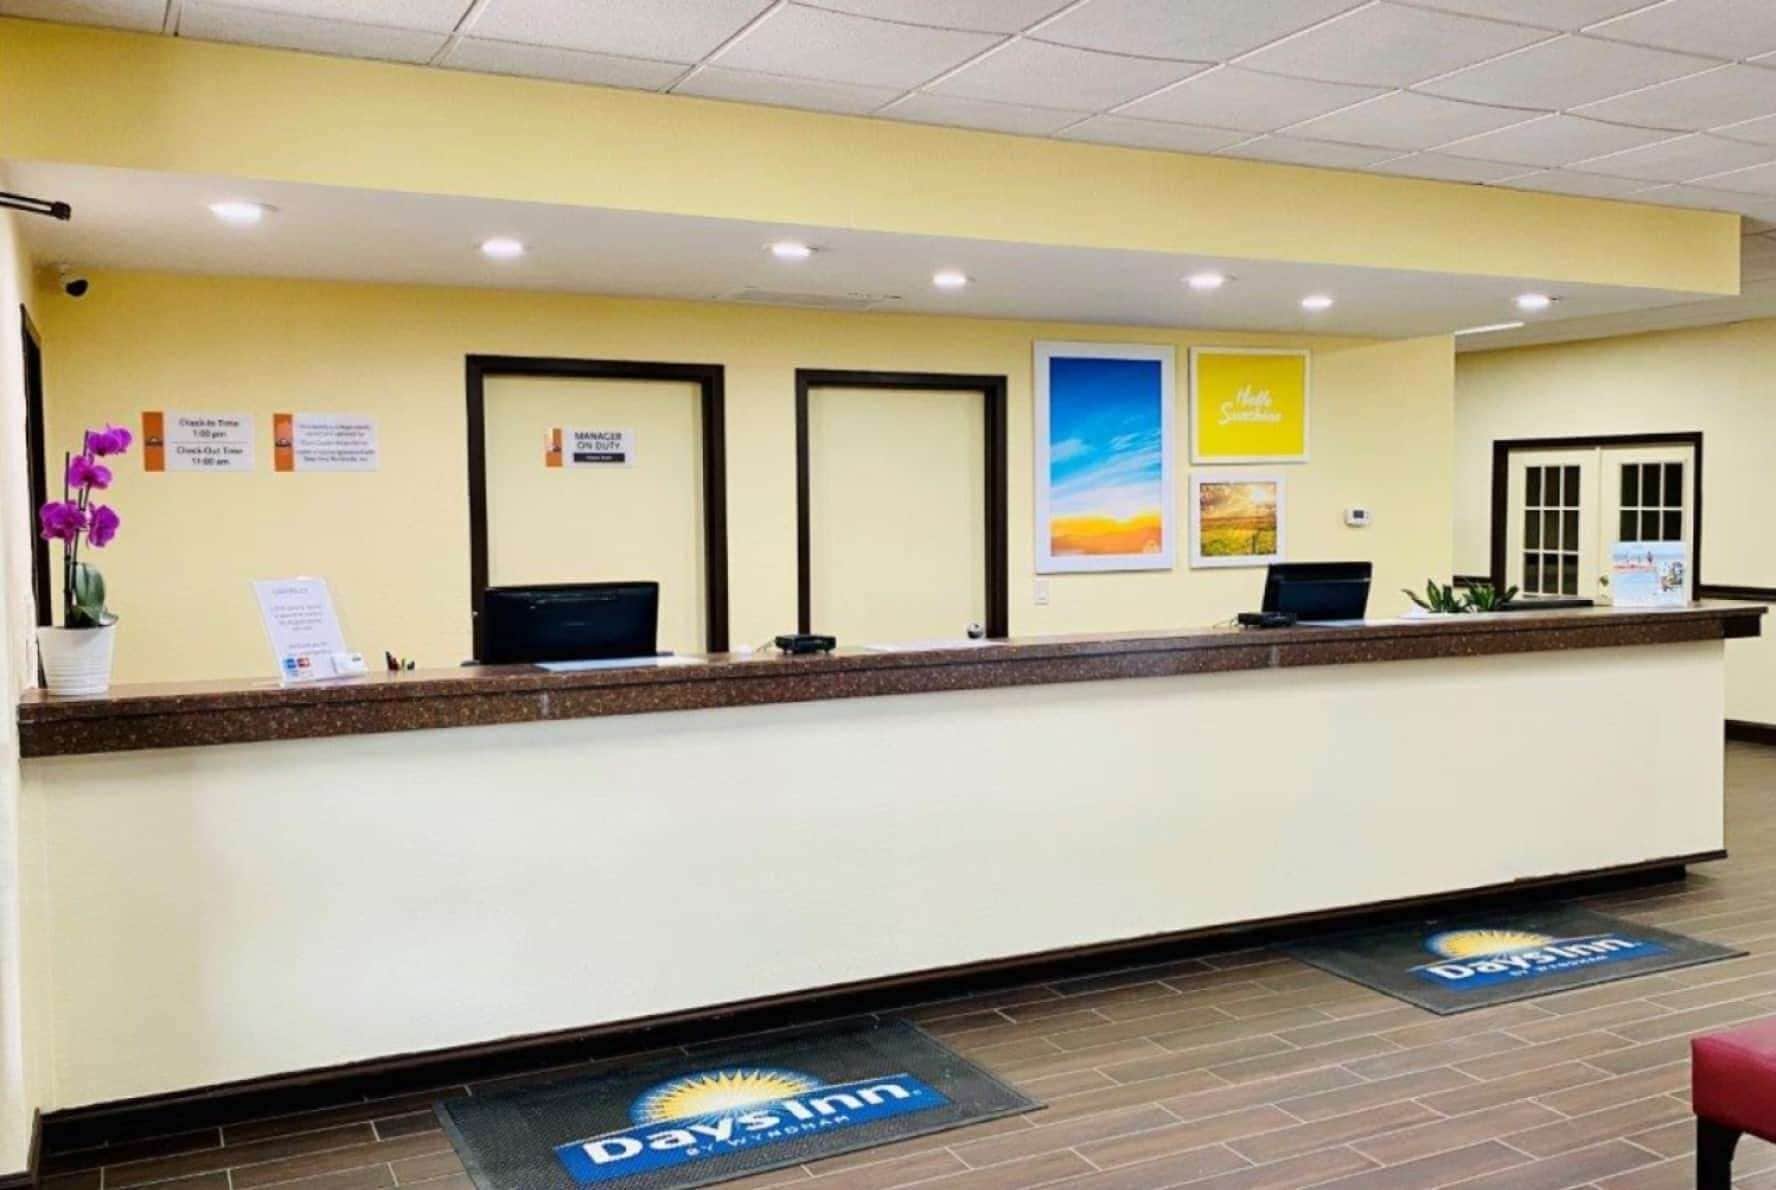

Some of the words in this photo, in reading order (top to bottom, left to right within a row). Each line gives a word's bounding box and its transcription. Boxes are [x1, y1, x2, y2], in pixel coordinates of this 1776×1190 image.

[575, 432, 622, 440] MANAGER
[577, 441, 593, 449] ON
[595, 441, 620, 450] DUTY
[582, 1108, 780, 1164] Days
[782, 1080, 911, 1119] Inn
[727, 1115, 850, 1147] WYNDHAM
